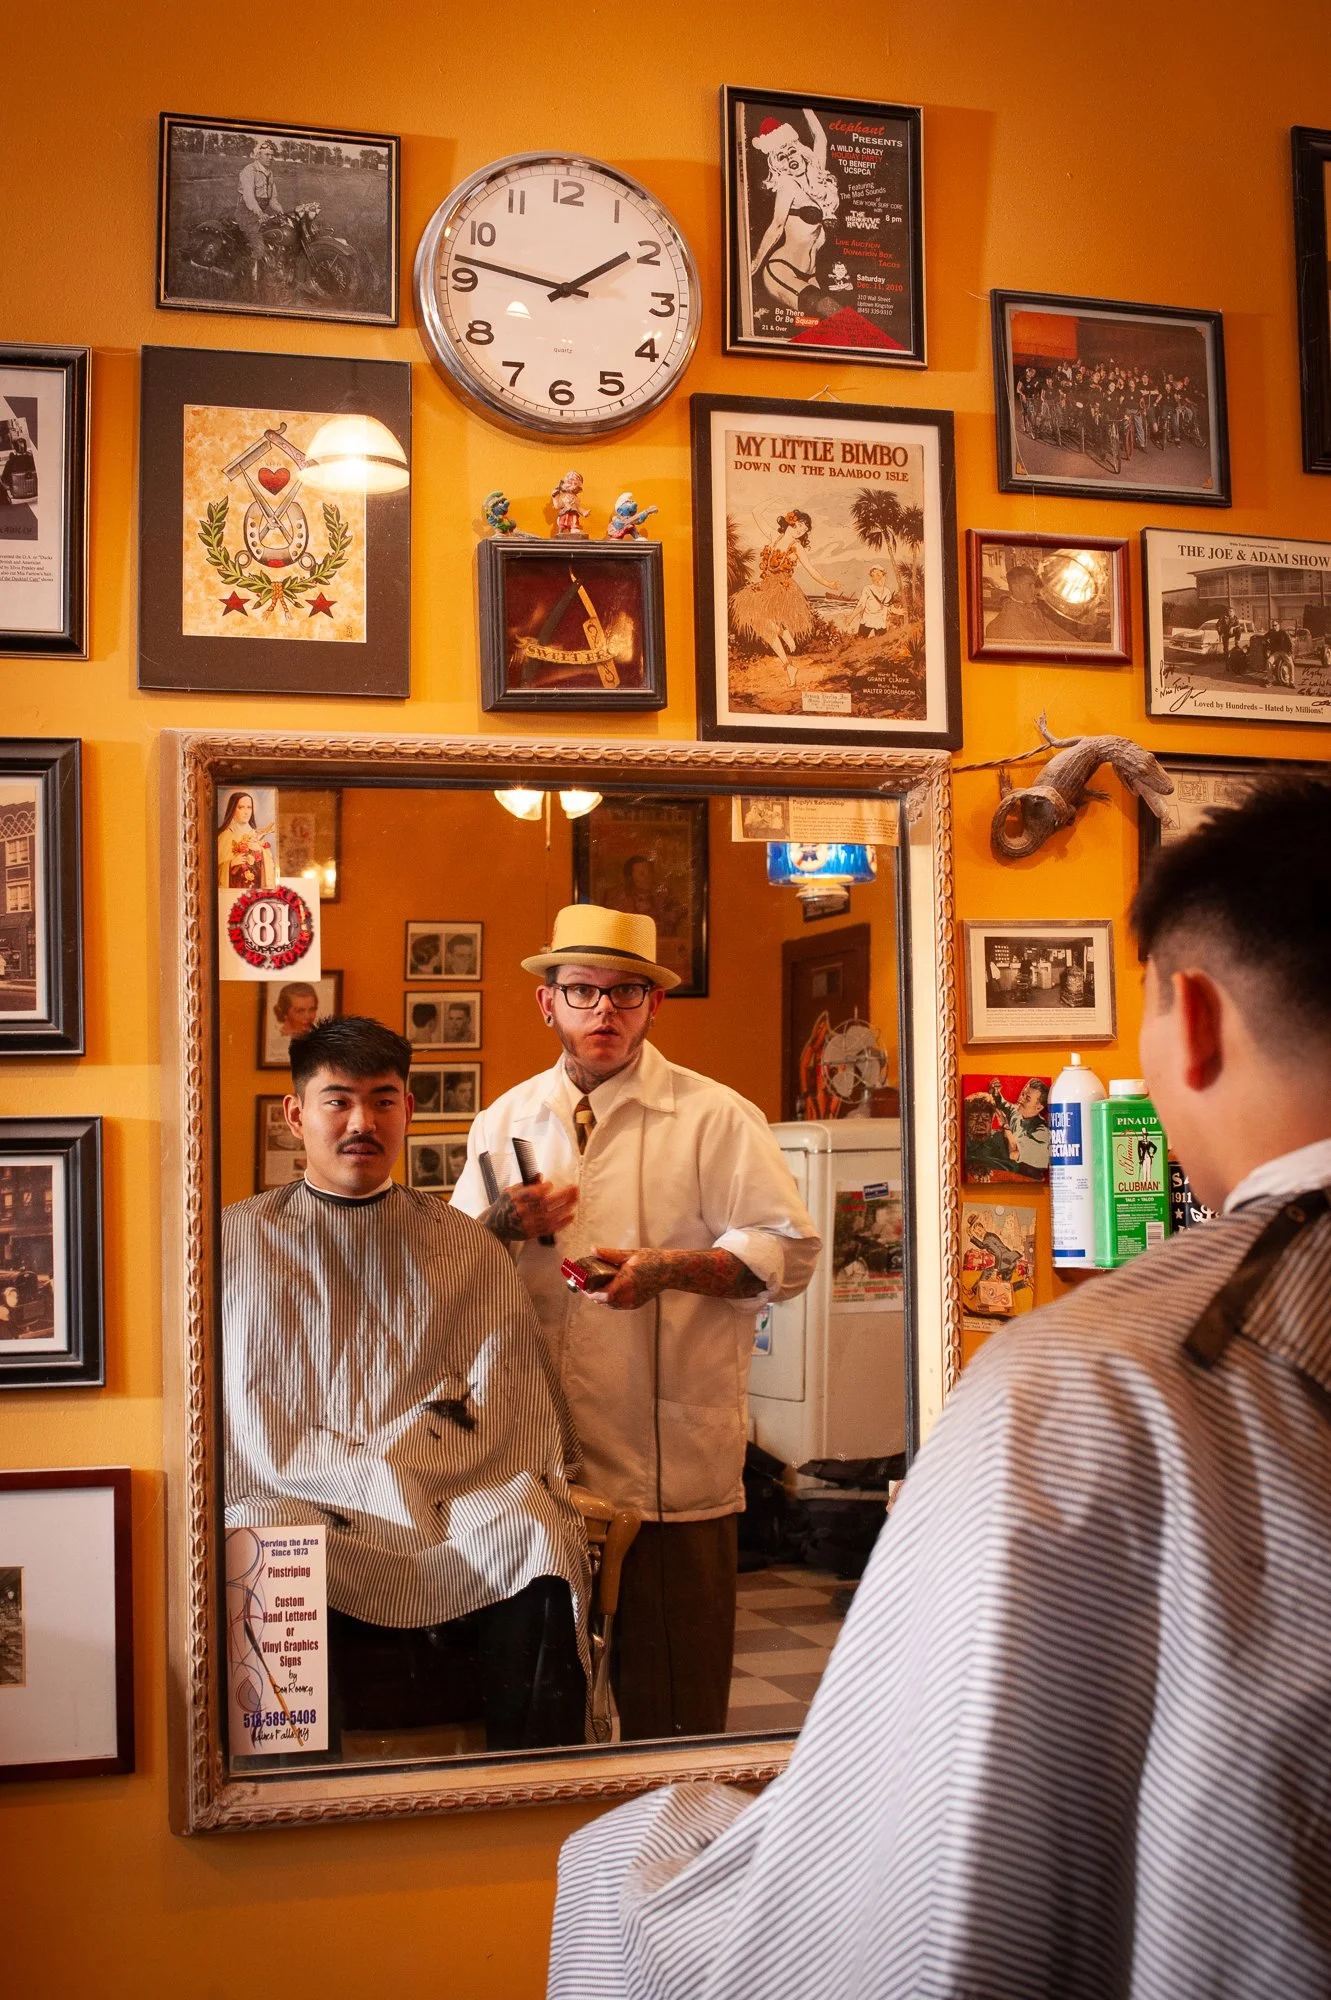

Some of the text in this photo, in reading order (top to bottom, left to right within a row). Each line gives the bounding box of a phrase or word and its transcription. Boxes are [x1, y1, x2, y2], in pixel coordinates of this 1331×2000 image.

[829, 120, 885, 135] elephant
[852, 133, 903, 147] PRESENTS
[831, 152, 883, 162] HOLIDAY PARTY
[837, 145, 853, 153] WILD
[861, 147, 884, 156] CRAZY
[844, 167, 871, 175] UCSPCA
[849, 160, 876, 169] BENEFIT
[553, 179, 585, 207] 12
[848, 182, 875, 191] Featuring
[865, 187, 886, 196] Sounds
[508, 189, 525, 215] 11
[614, 200, 620, 223] 1
[850, 210, 865, 218] THE
[470, 221, 496, 247] 10
[637, 240, 661, 267] 2
[451, 267, 478, 292] 9
[857, 274, 885, 284] Saturday
[886, 284, 904, 292] 2010
[649, 292, 675, 317] 3
[786, 309, 804, 317] There
[795, 317, 819, 325] Square
[466, 320, 494, 345] 8
[635, 337, 659, 362] 4
[502, 361, 525, 387] 7
[597, 371, 625, 396] 5
[549, 380, 575, 405] 6
[735, 435, 908, 467] MY LITTLE BIMBO
[734, 460, 909, 482] DOWN ON THE BAMBOO ISLE
[1178, 544, 1330, 567] THE JOE & ADAM SHOW
[528, 644, 577, 662] SWEET
[1194, 700, 1214, 708] Loved
[1215, 701, 1224, 710] by
[1225, 702, 1258, 711] Hundreds
[1265, 704, 1284, 712] Hated
[1286, 705, 1294, 714] by
[252, 903, 290, 946] 81
[228, 927, 266, 966] NEW
[245, 940, 295, 954] SUPPORT
[1117, 1117, 1157, 1125] PINAUD
[1118, 1181, 1159, 1192] CLUBMAN
[1172, 1192, 1192, 1203] 1911
[261, 1540, 287, 1548] Serving
[268, 1566, 311, 1578] Pinstriping
[275, 1596, 304, 1607] Custom
[263, 1609, 317, 1623] Hand Lettered
[286, 1627, 294, 1636] or
[262, 1639, 319, 1653] Vinyl Graphics
[280, 1656, 301, 1668] Signs
[289, 1669, 297, 1682] by
[274, 1684, 287, 1694] Don
[243, 1709, 316, 1728] 518-589-5408
[297, 1727, 309, 1741] NY
